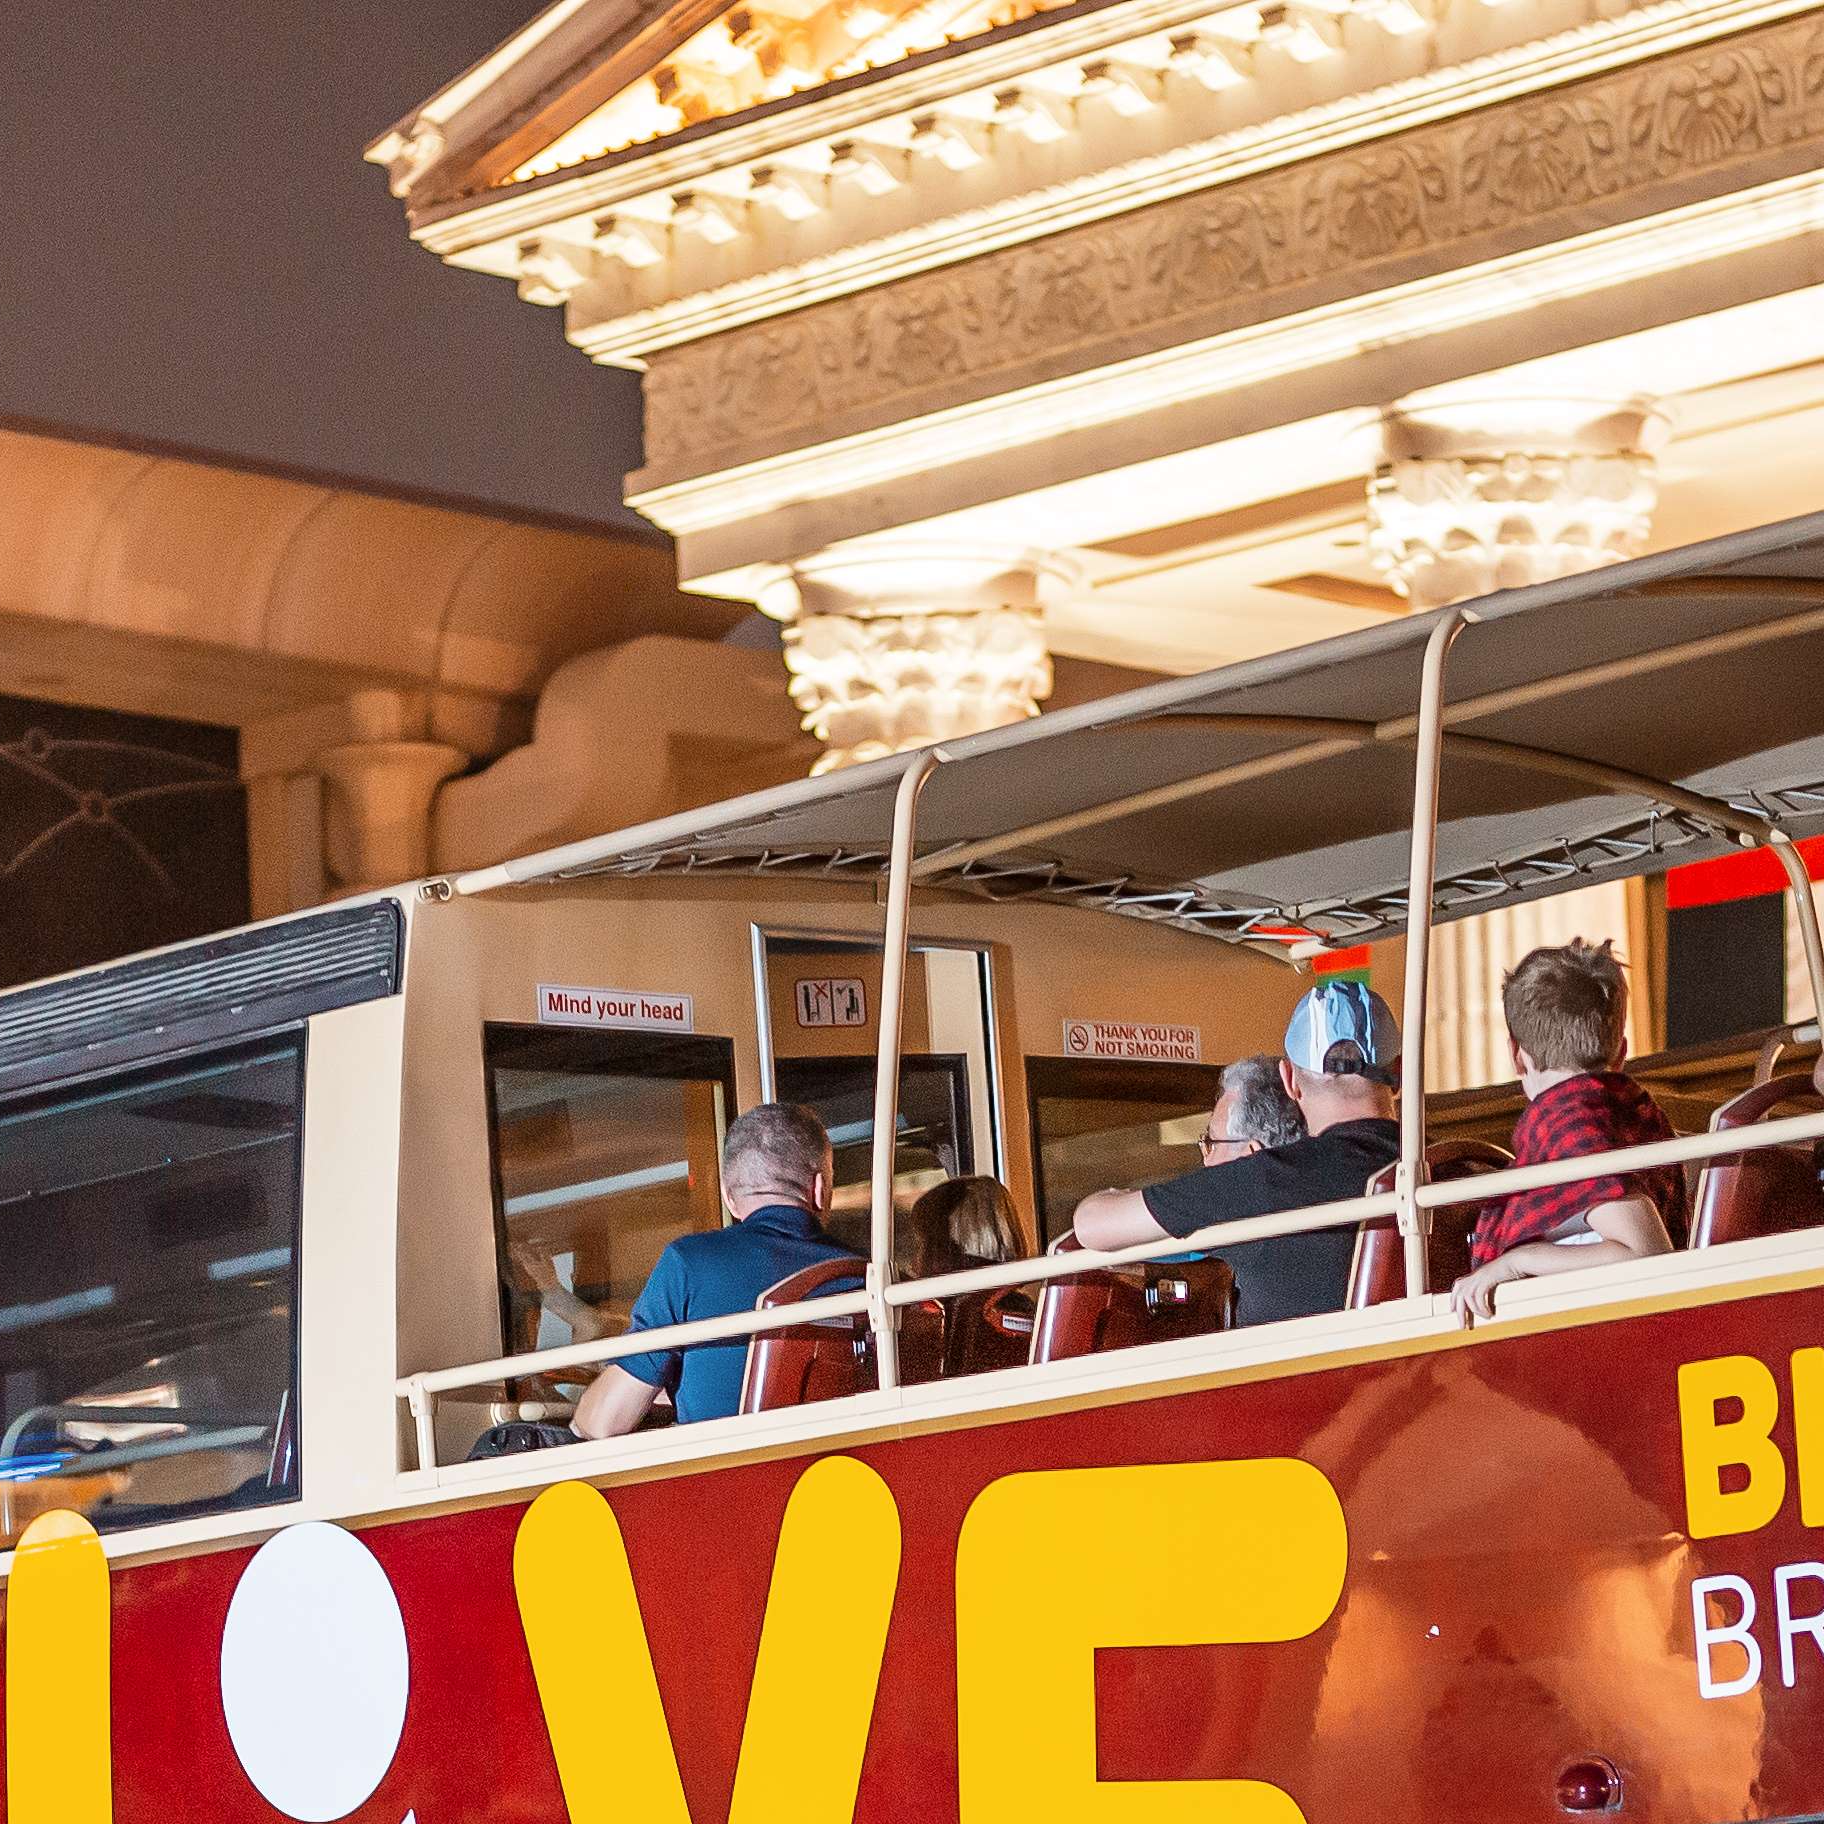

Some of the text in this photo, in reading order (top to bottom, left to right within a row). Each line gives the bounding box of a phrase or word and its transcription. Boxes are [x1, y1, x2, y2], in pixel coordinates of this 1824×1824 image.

[548, 992, 684, 1021] Mind your head
[1093, 1024, 1194, 1043] THANK YOU FOR
[1095, 1040, 1195, 1059] NOT SMOKING
